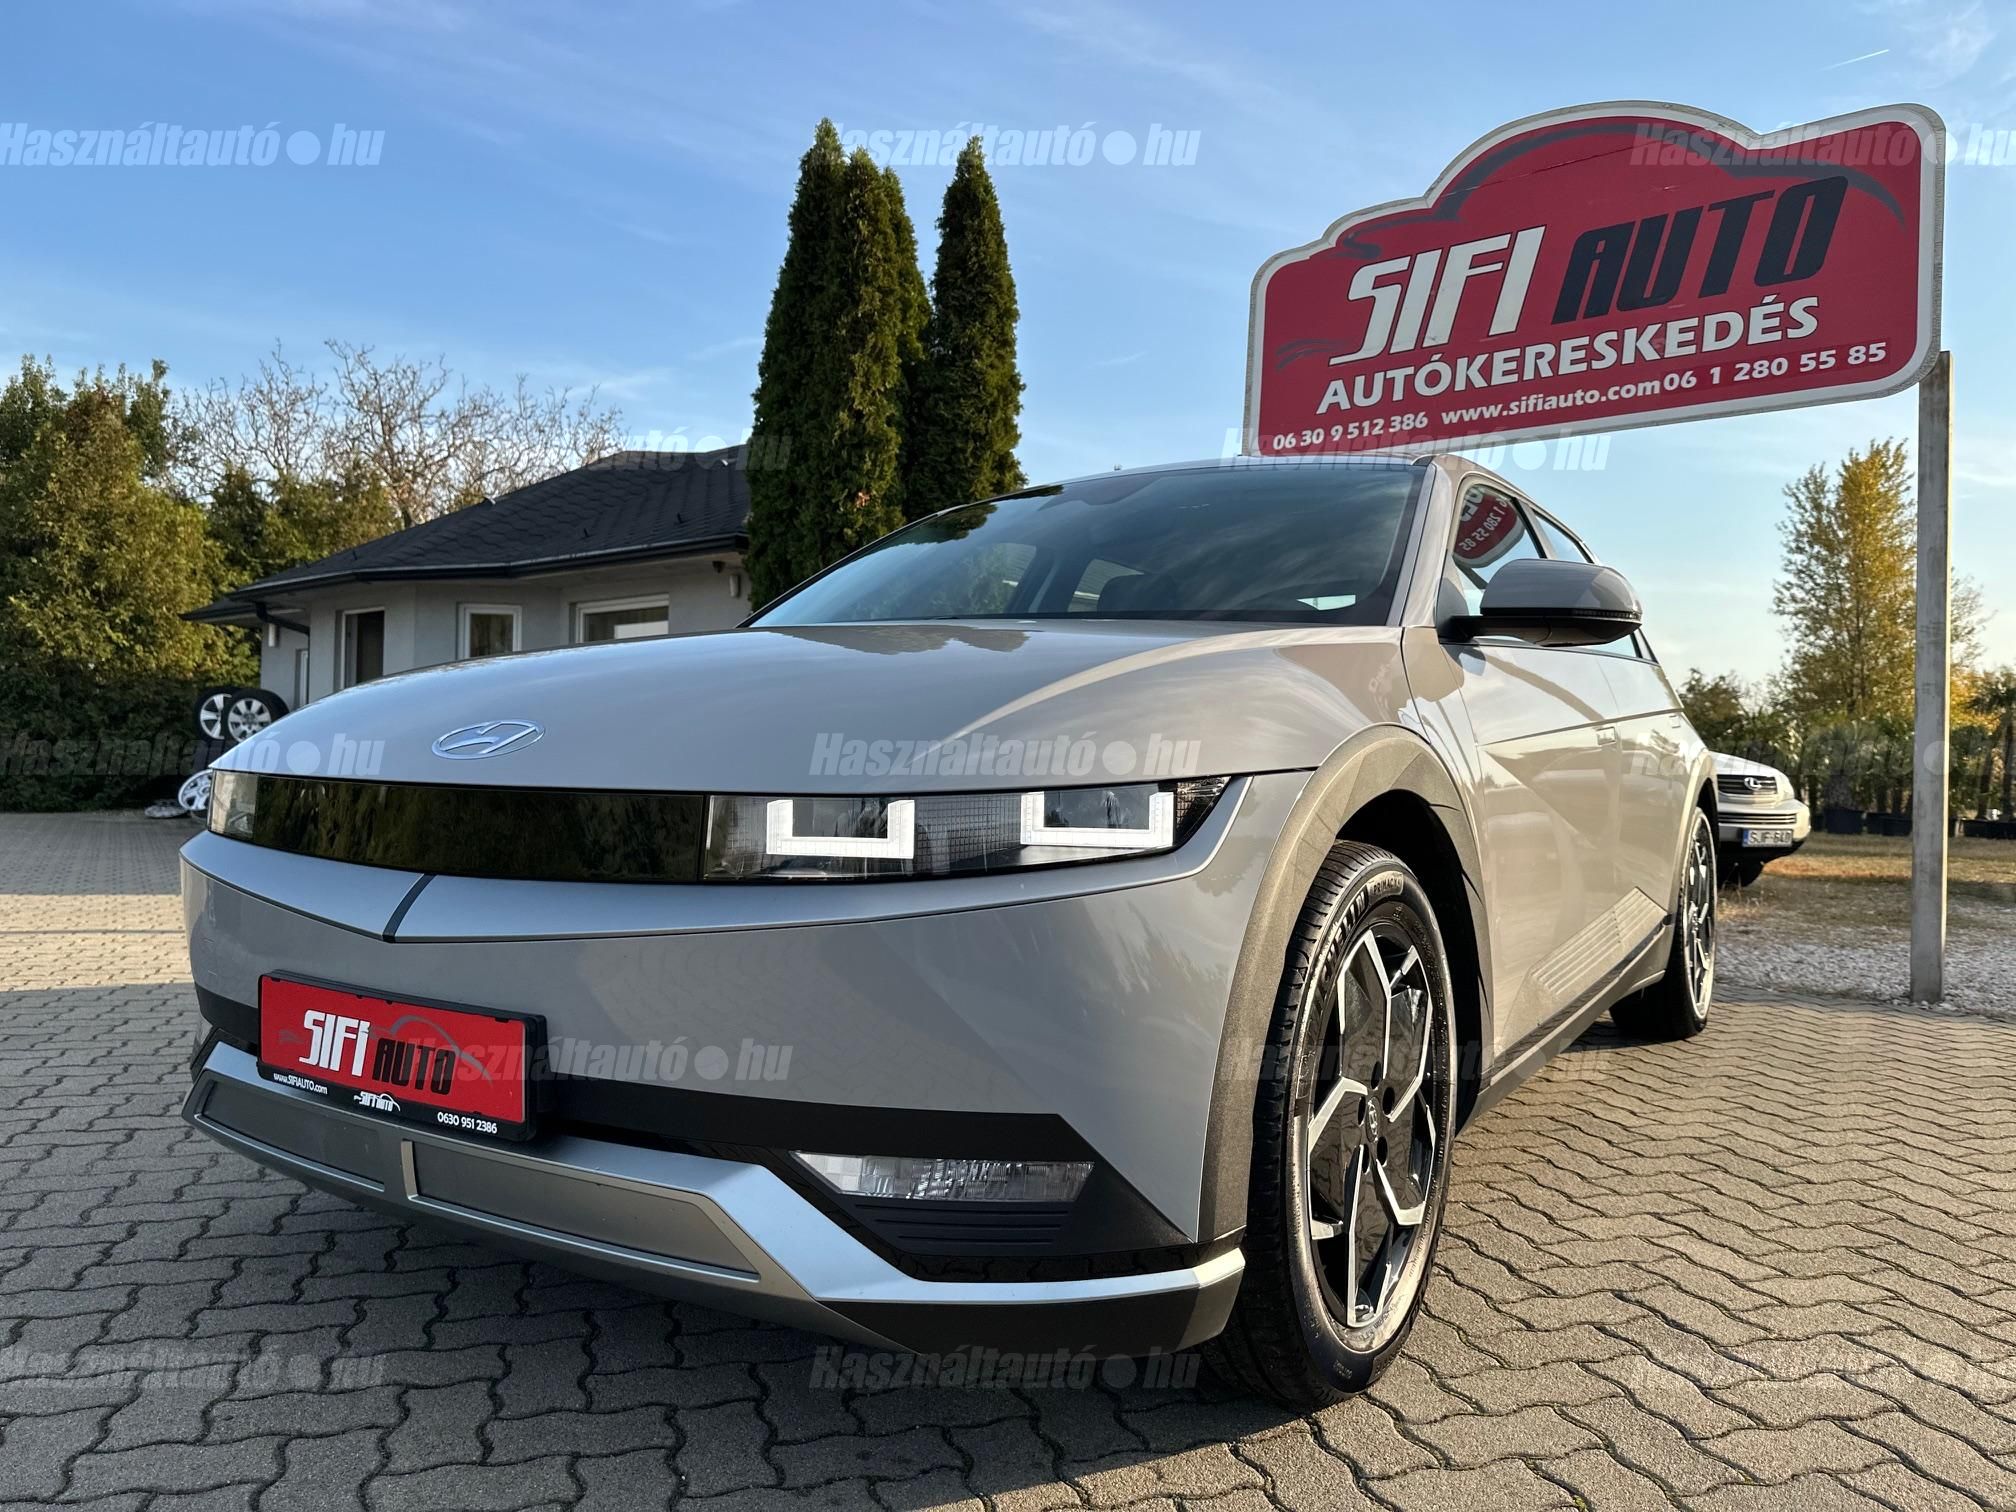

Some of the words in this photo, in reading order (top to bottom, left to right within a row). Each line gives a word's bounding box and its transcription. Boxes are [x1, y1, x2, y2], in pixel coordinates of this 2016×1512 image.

[1329, 225, 1547, 367] SIFI
[1551, 175, 1849, 325] AUTO
[1273, 428, 1297, 450] 06
[1300, 428, 1325, 447] 30
[1330, 425, 1344, 442] 9
[1347, 417, 1385, 439] 512
[1388, 411, 1429, 433] 386
[1441, 378, 1661, 426] www.sifiauto.com
[1663, 373, 1698, 390] 06
[1709, 366, 1722, 385] 1
[1733, 357, 1789, 382] 280
[1799, 350, 1837, 373] 55
[1847, 342, 1887, 366] 85
[1315, 294, 1821, 415] AUTÓKERESKEDÉS
[372, 1038, 457, 1096] AUTO
[437, 1111, 460, 1126] 0630
[461, 1116, 475, 1130] 951
[476, 1119, 498, 1134] 2386
